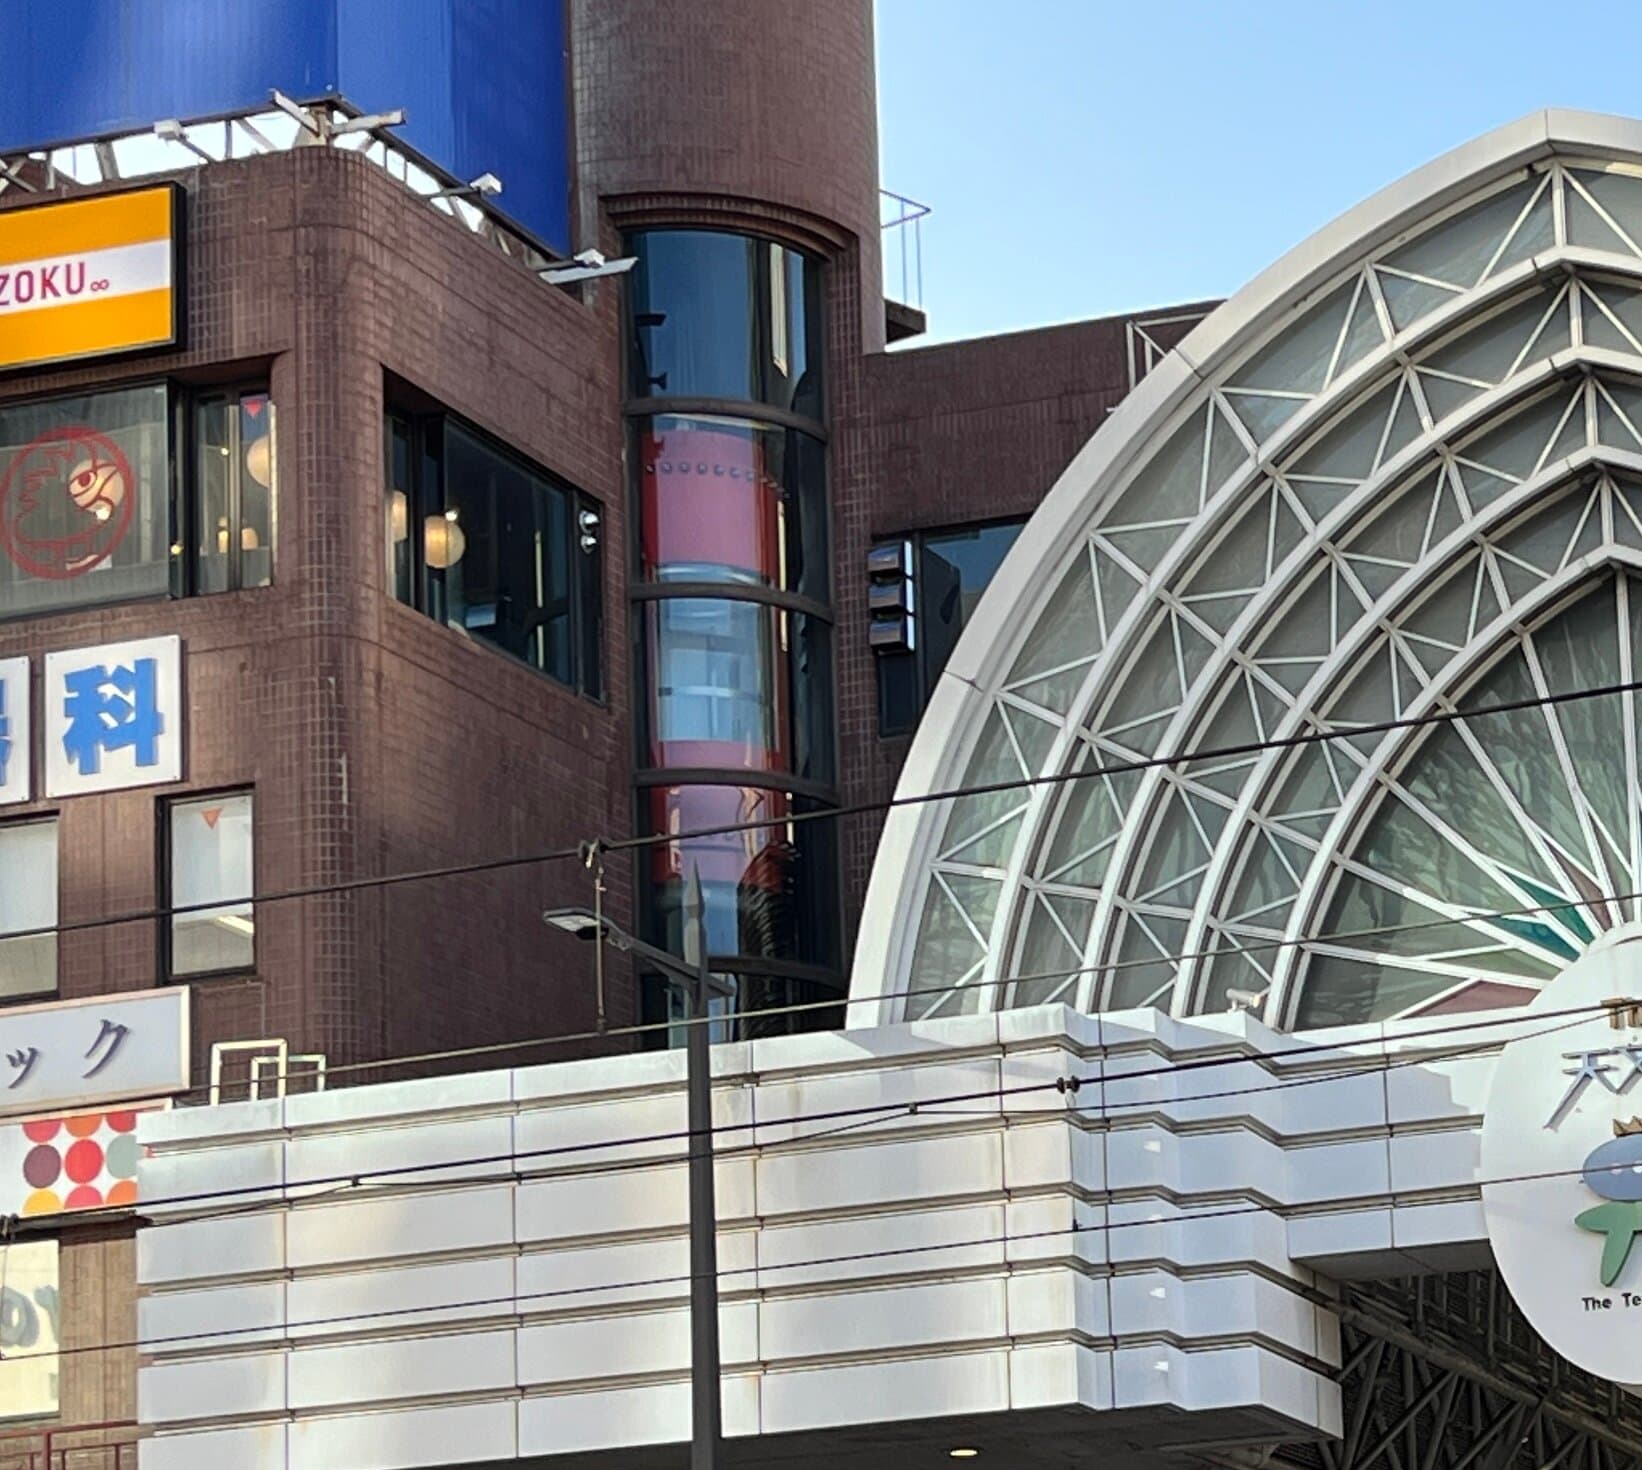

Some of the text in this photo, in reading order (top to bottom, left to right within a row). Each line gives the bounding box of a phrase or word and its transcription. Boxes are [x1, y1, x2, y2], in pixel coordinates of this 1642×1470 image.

[62, 657, 165, 776] 科
[5, 1018, 131, 1090] ック
[1582, 1296, 1612, 1312] The
